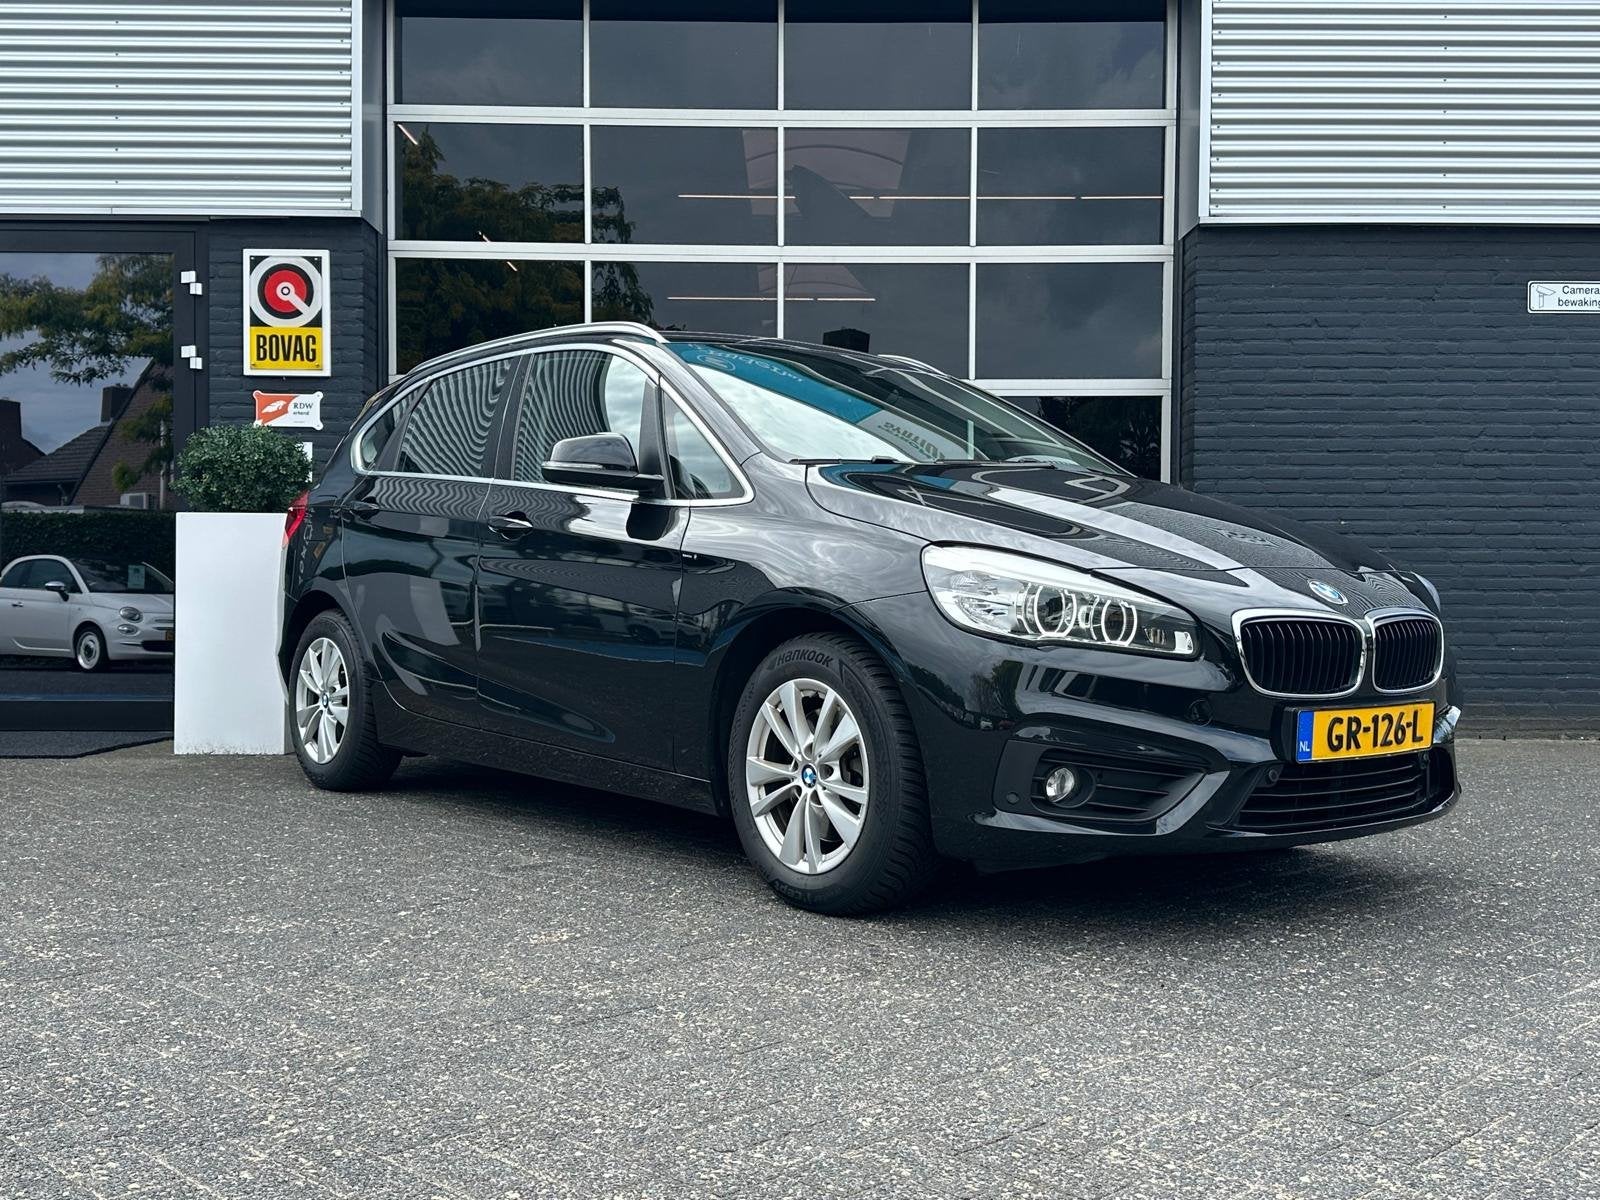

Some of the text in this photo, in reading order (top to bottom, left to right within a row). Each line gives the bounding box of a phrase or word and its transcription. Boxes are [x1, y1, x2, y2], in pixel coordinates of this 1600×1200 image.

[1562, 285, 1600, 295] Camera
[256, 333, 317, 363] BOVAG
[292, 402, 314, 410] RDW
[1326, 709, 1424, 753] GR-126-L
[1299, 741, 1311, 752] NL
